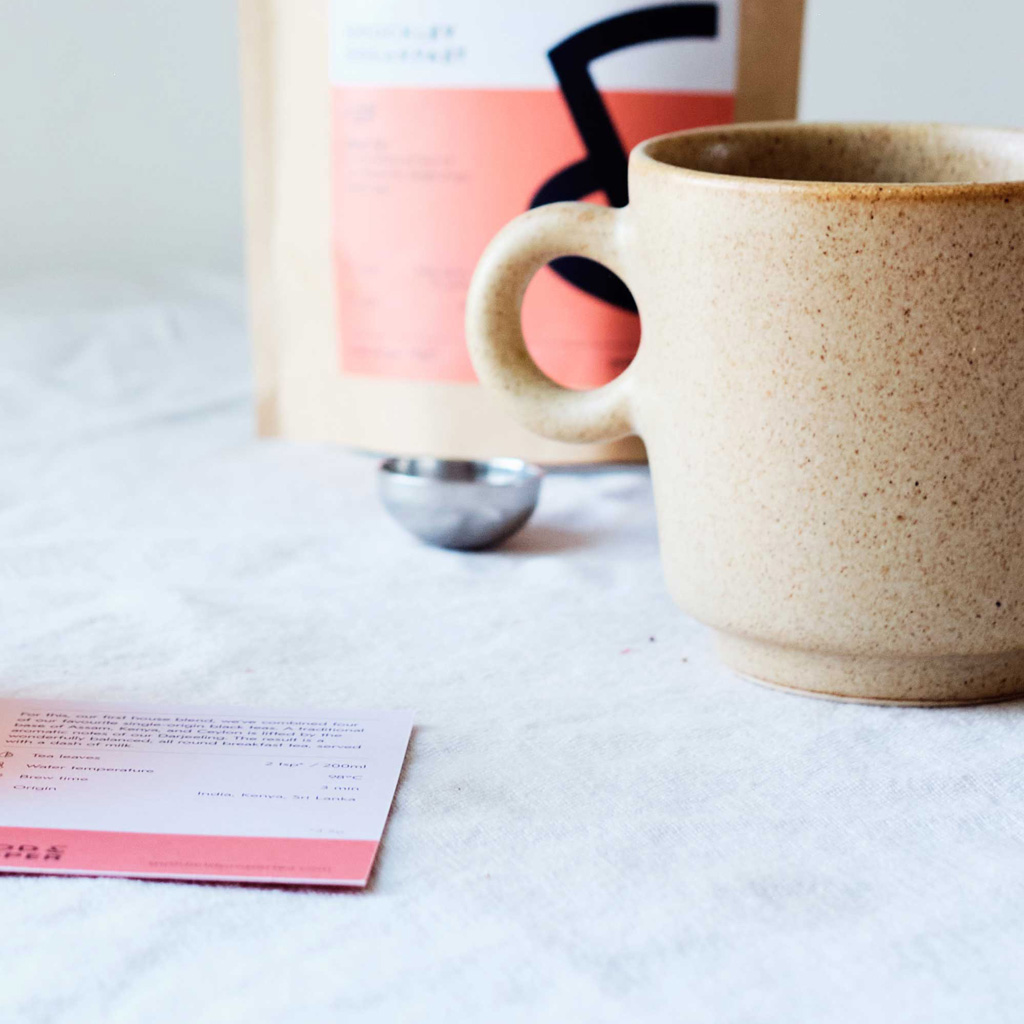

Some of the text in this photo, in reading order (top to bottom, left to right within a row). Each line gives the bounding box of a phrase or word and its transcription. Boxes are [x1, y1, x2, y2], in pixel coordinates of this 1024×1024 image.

[59, 753, 101, 761] leaves
[71, 765, 155, 774] temperature
[13, 784, 58, 792] Origin
